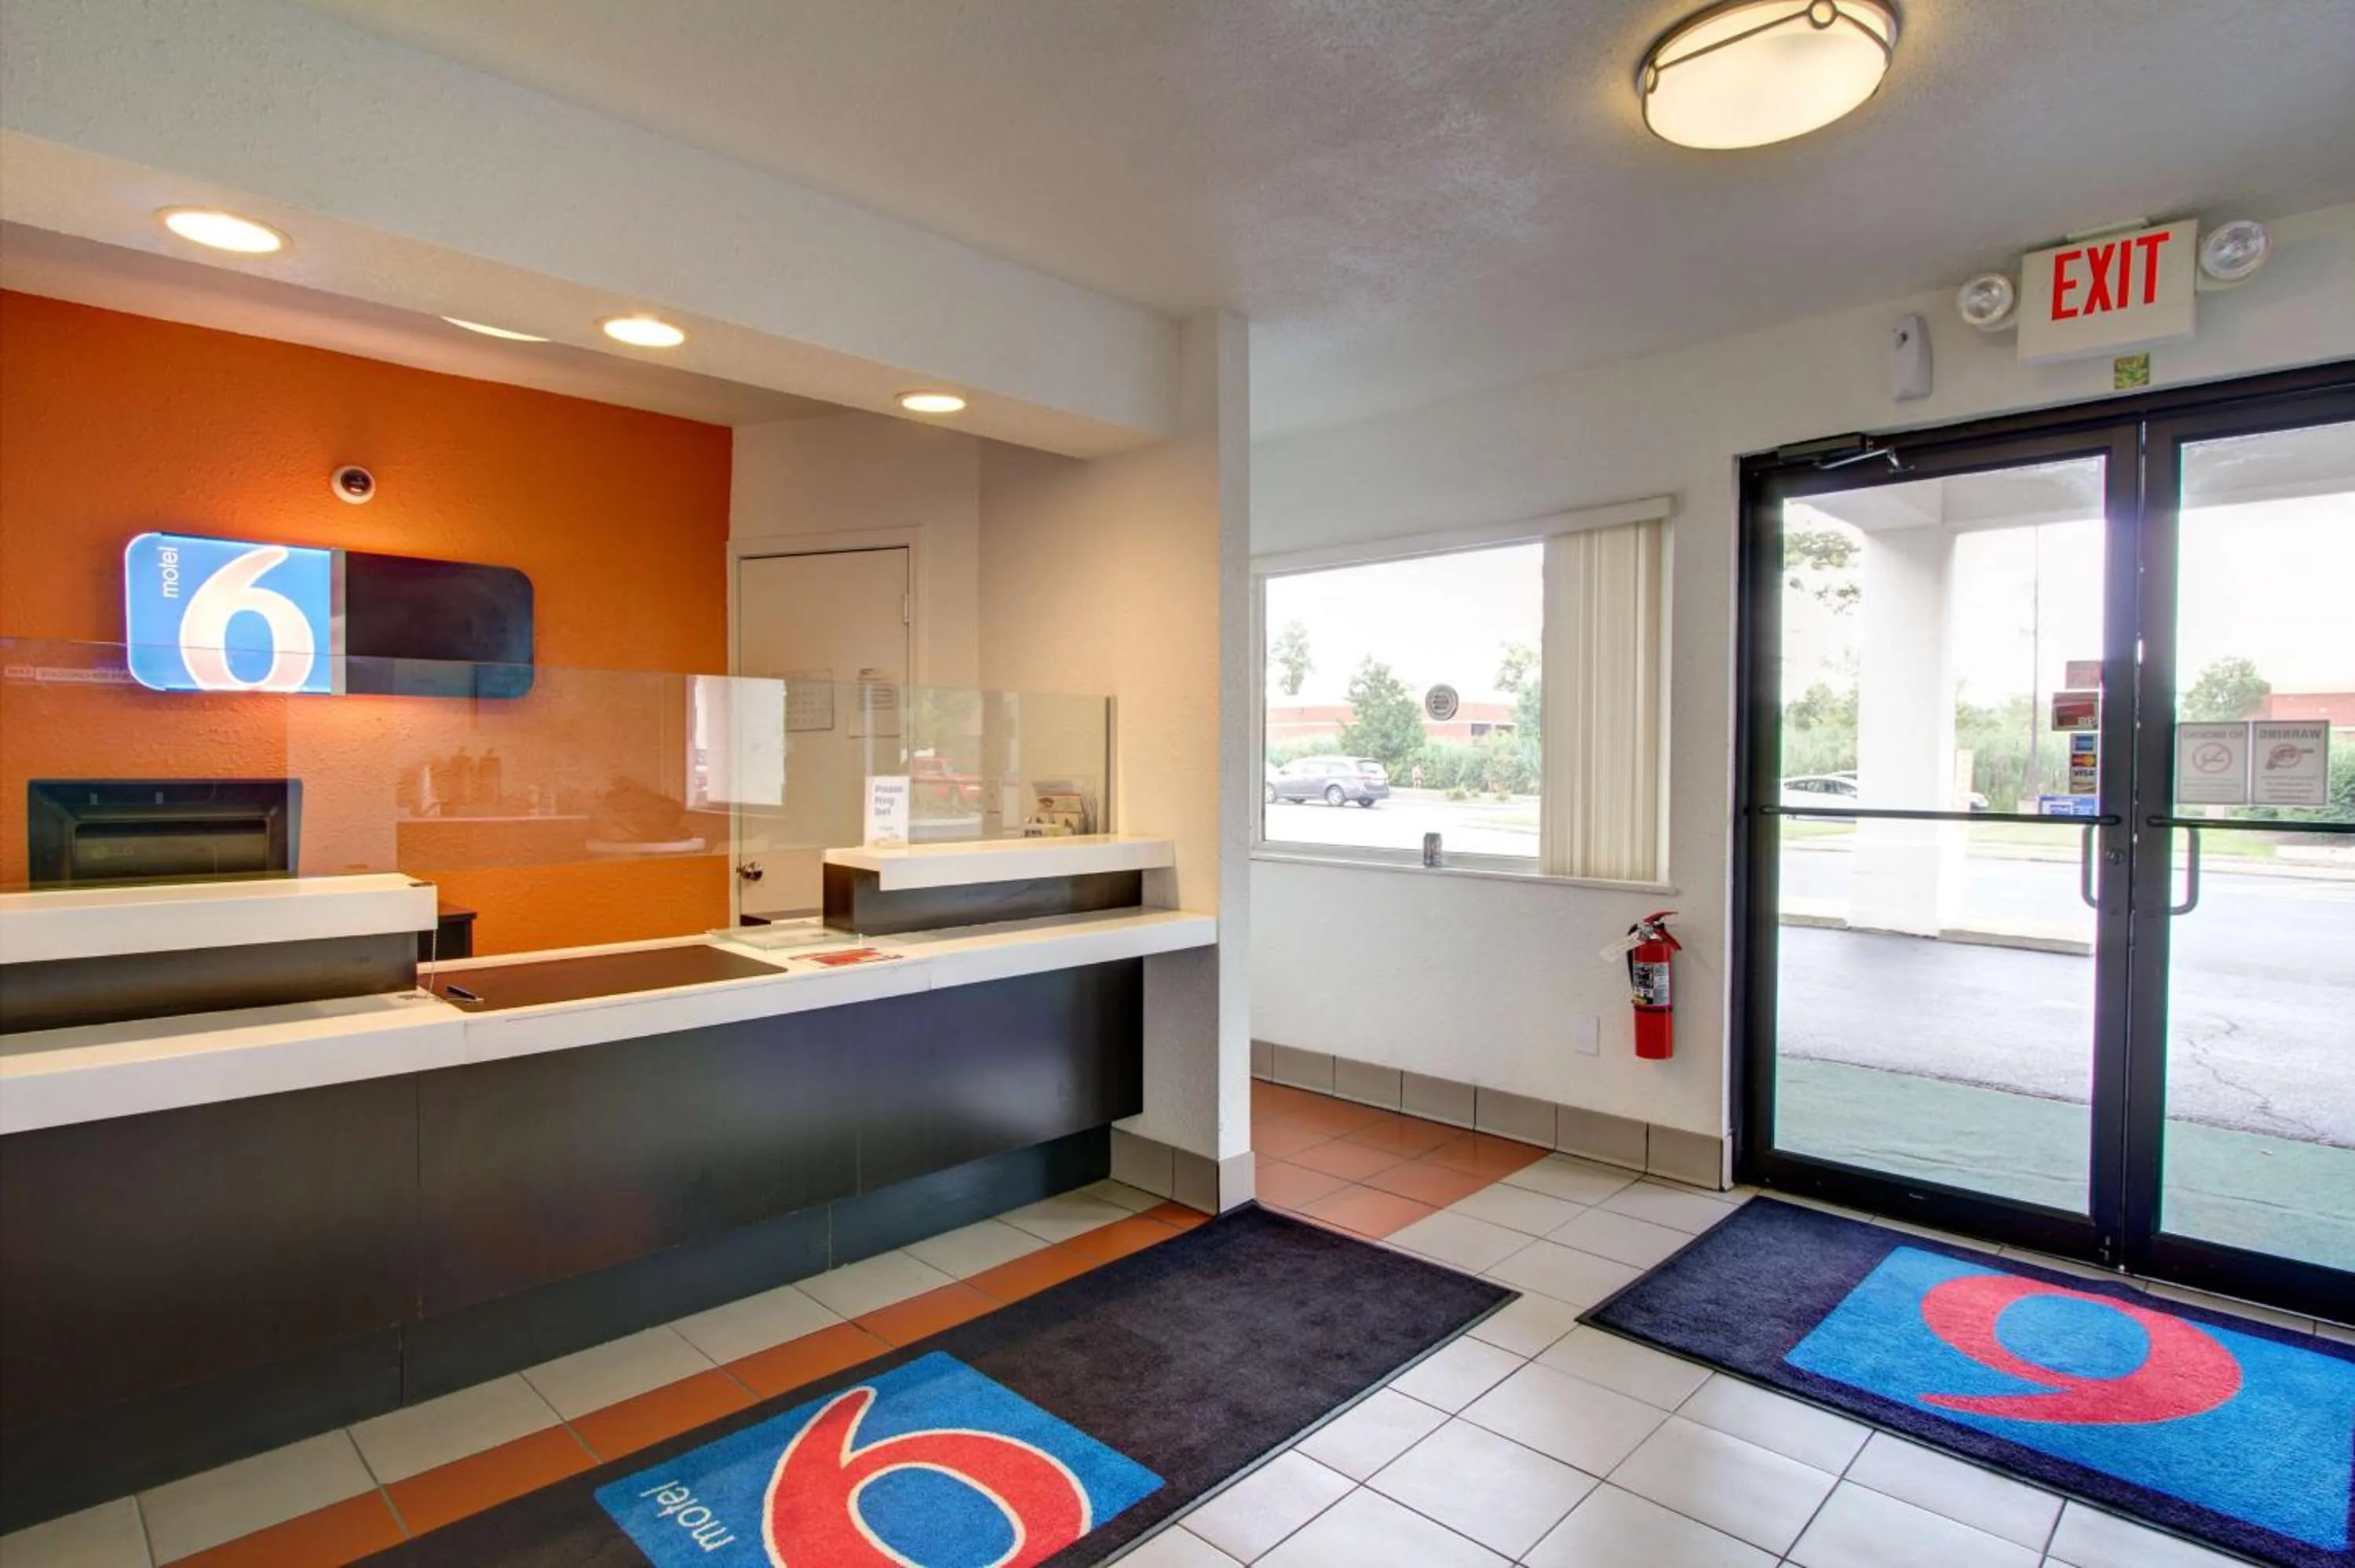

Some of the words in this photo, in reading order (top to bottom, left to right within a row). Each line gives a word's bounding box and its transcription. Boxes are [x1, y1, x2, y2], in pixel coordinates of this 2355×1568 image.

[2051, 232, 2170, 321] EXIT
[158, 546, 179, 599] motel
[179, 545, 314, 693] 6
[639, 1481, 736, 1553] motel
[762, 1385, 1093, 1568] 6
